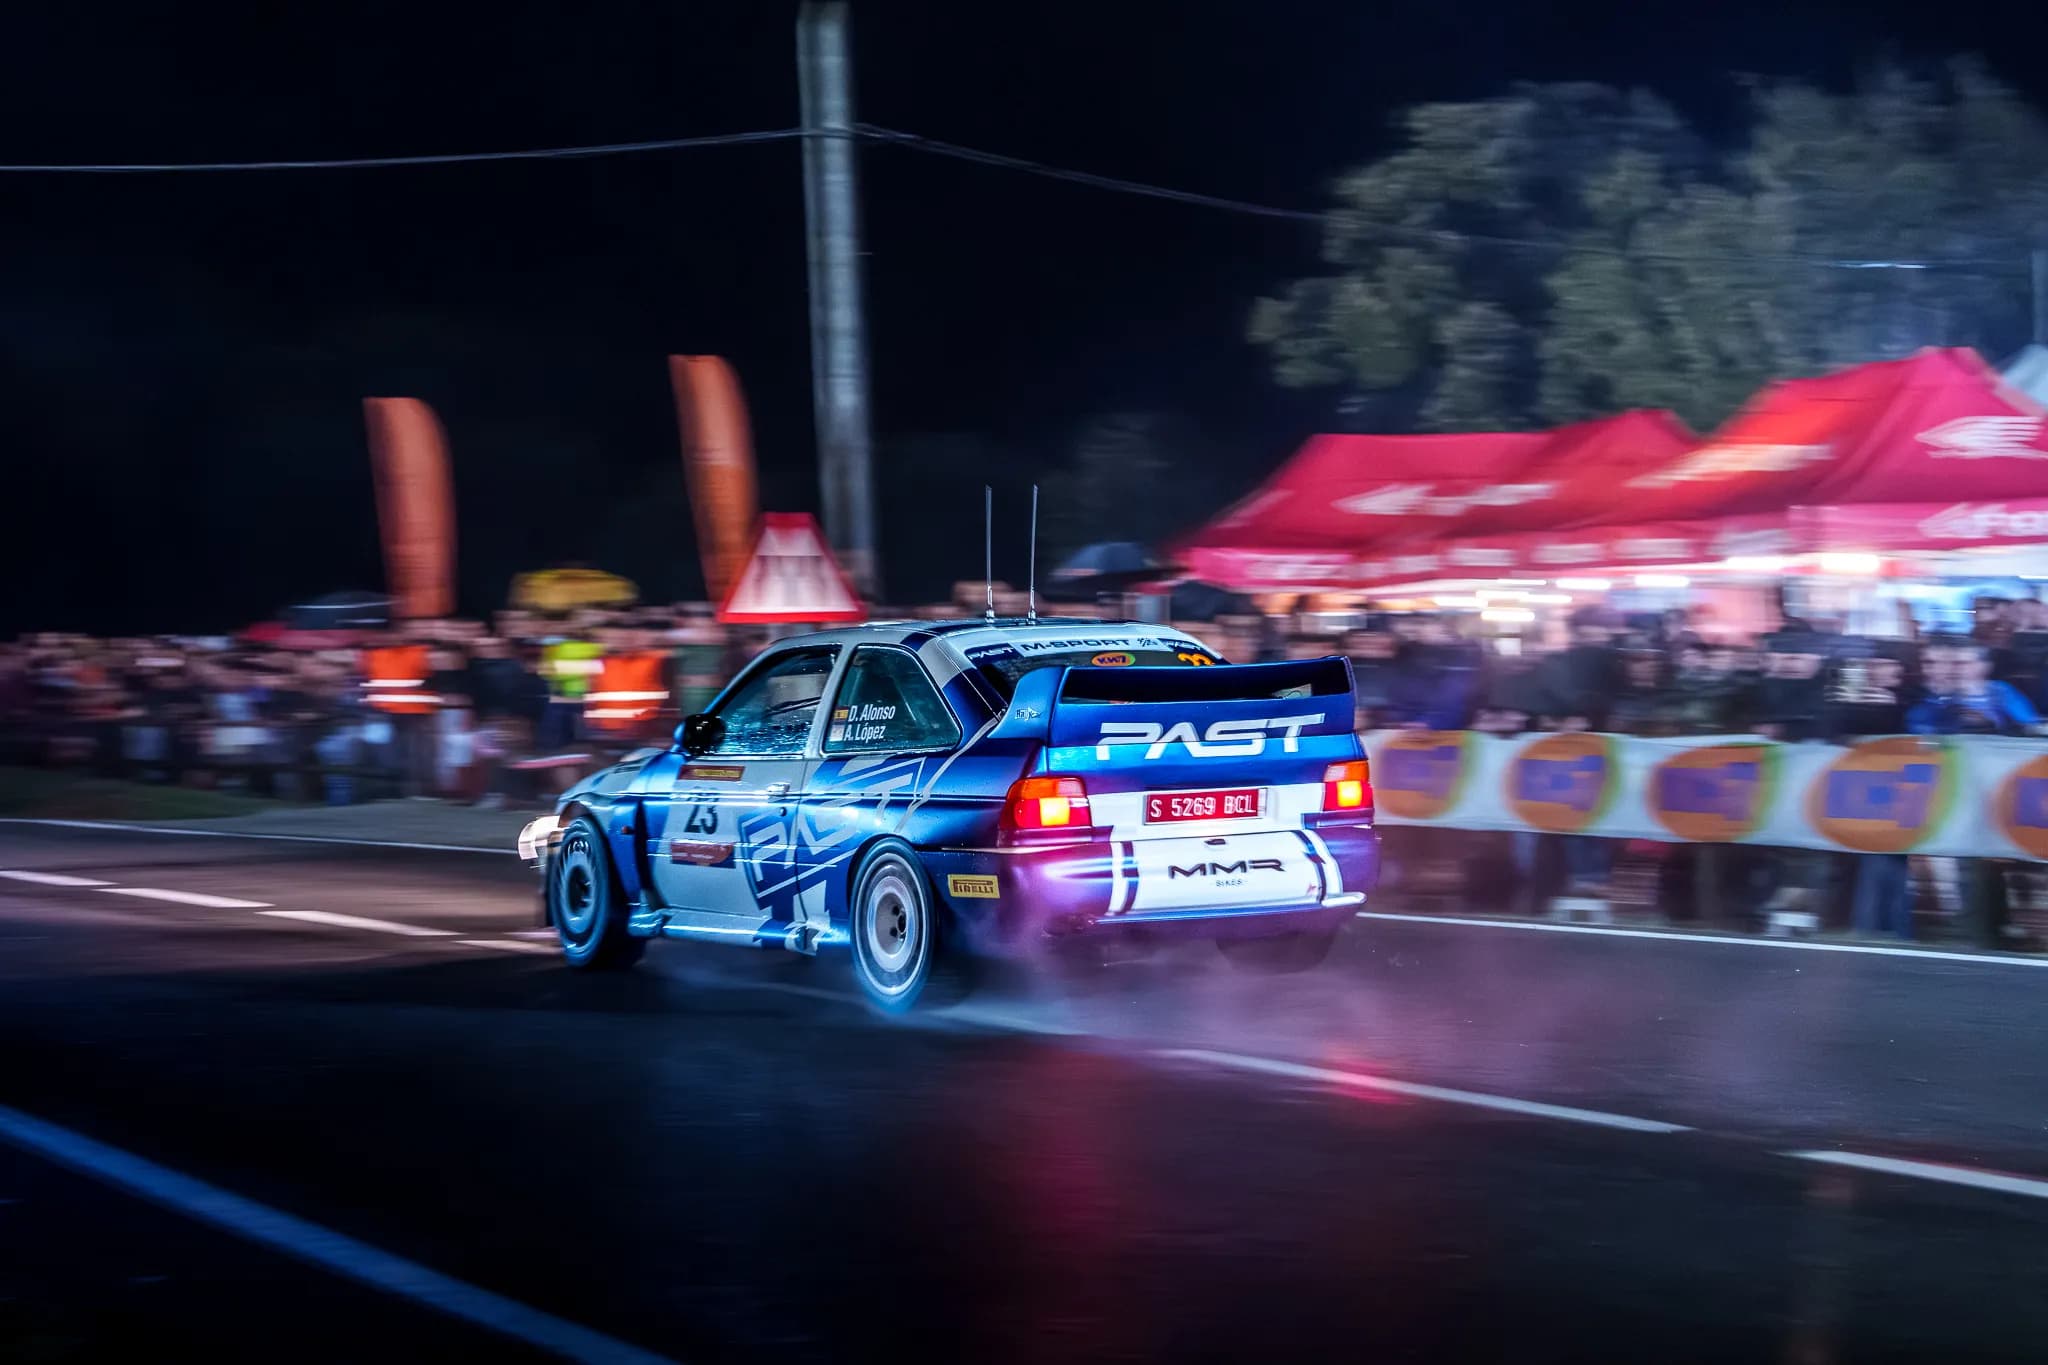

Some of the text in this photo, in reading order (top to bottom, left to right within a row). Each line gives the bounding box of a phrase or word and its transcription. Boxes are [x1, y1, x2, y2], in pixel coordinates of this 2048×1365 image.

[1021, 640, 1130, 651] M-SPORT
[848, 704, 896, 722] D. Alonso
[844, 722, 886, 743] A. López
[1096, 713, 1325, 761] PAST
[684, 786, 720, 835] 23
[1150, 794, 1257, 818] S 5269 BCL
[1168, 859, 1287, 880] MMR
[952, 879, 994, 893] PIRELLI
